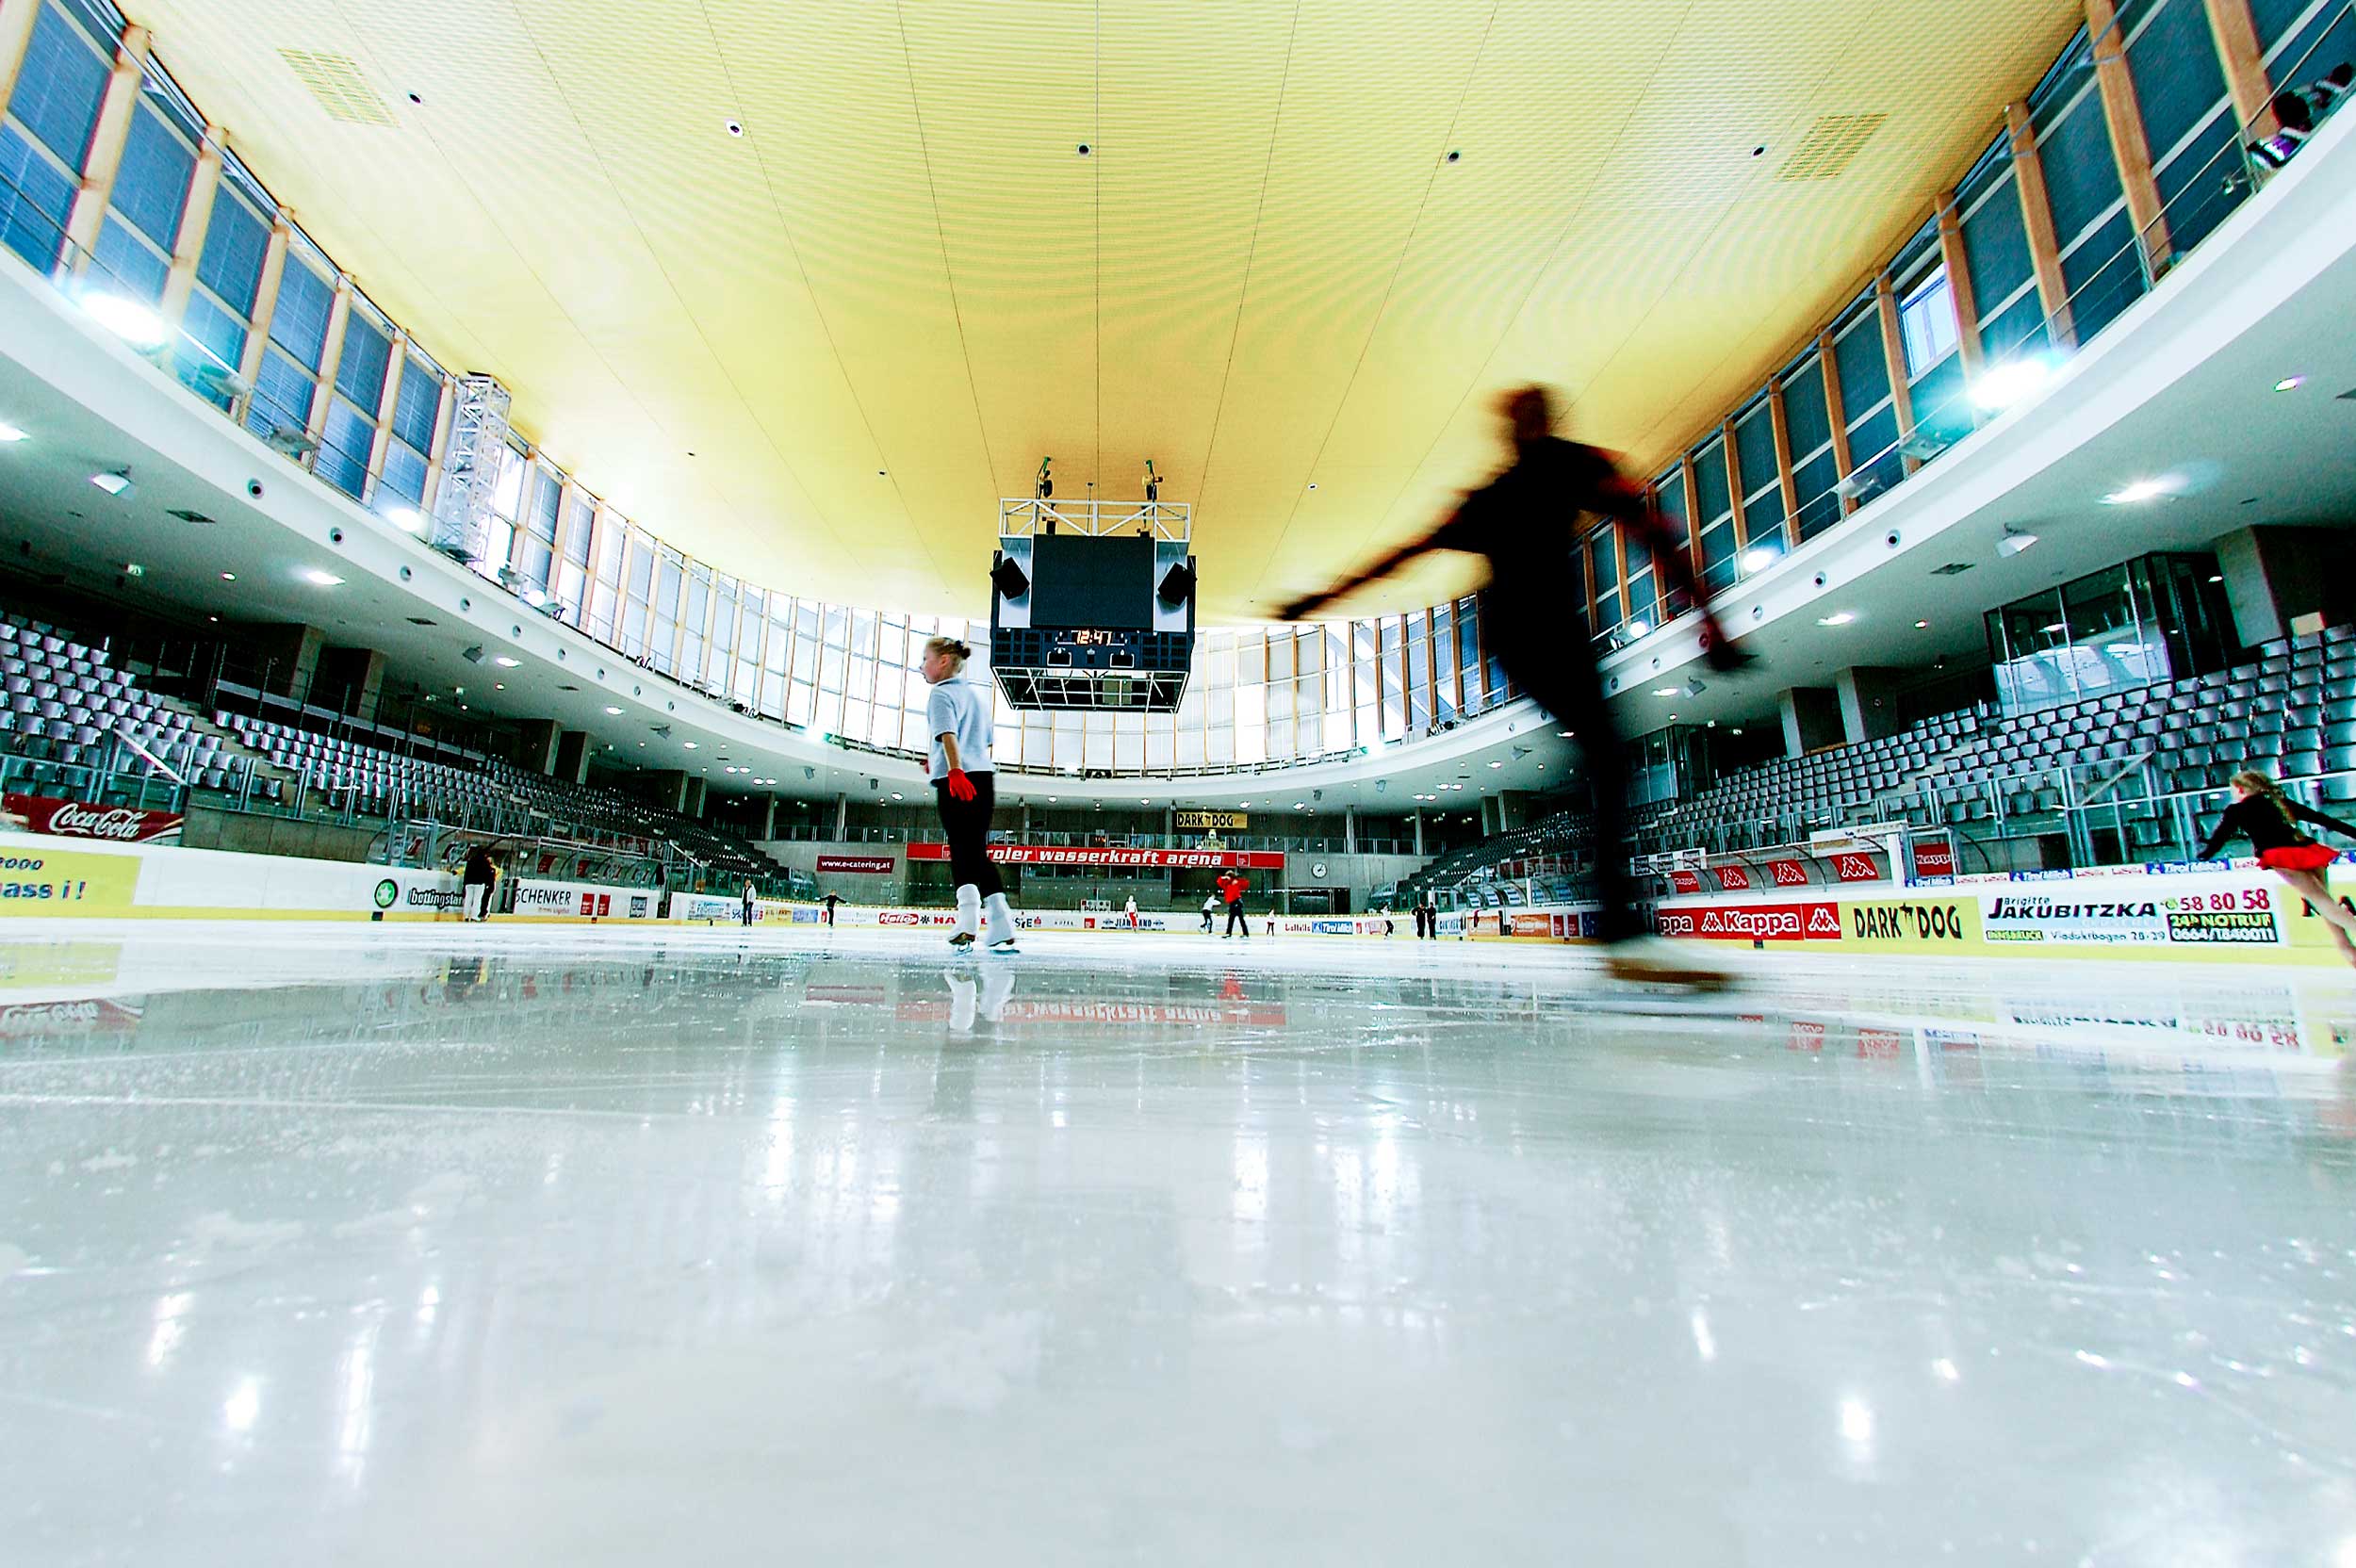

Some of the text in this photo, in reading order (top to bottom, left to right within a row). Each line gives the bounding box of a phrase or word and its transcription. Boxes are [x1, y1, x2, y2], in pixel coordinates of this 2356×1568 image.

[1178, 814, 1234, 826] DARK DOG
[821, 860, 891, 870] www.e-catering.at
[986, 849, 1222, 866] roler wasserkraft arena
[0, 882, 53, 899] ass
[515, 888, 572, 906] SCHENKER
[2180, 889, 2270, 910] 58 80 58
[1988, 897, 2156, 919] JAKUBITZKA
[1660, 915, 1693, 935] ppa
[1724, 910, 1800, 936] Kappa
[1854, 905, 1962, 939] DARK DOG
